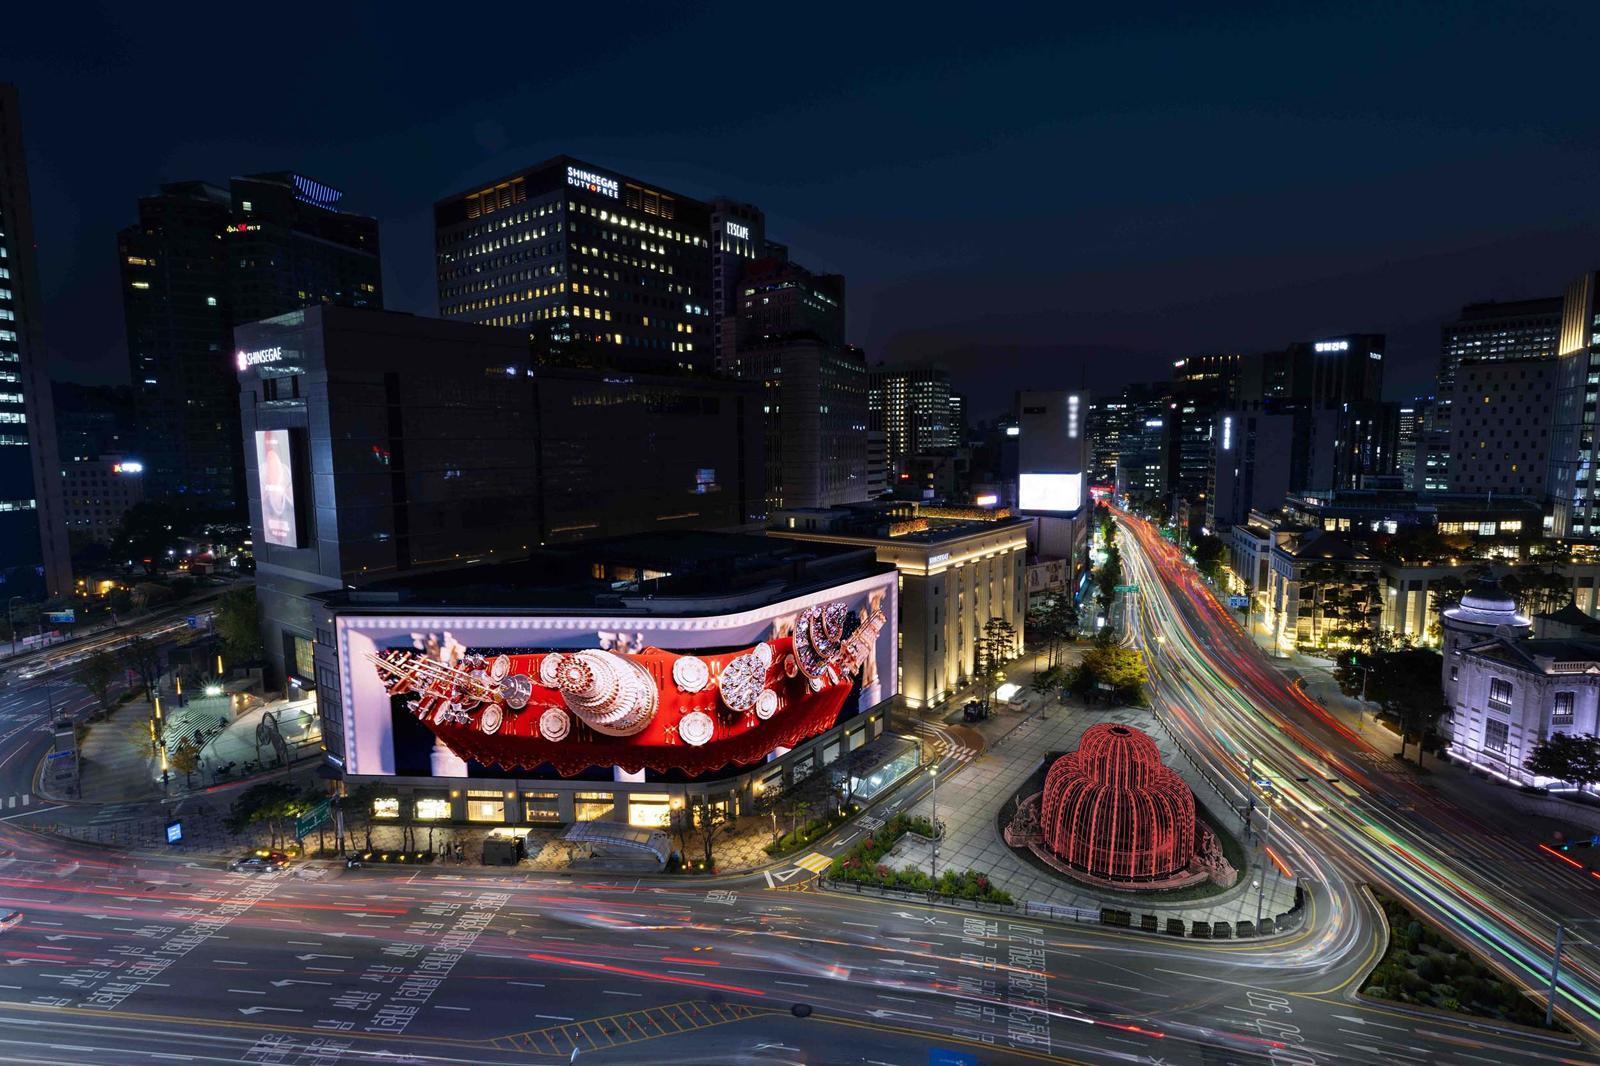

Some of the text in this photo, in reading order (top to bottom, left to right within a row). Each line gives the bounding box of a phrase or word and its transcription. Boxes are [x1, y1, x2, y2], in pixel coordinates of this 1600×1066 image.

[568, 167, 618, 190] SHINSEGAE
[568, 177, 618, 198] DUTY FREE
[247, 347, 282, 366] SHINSEGAE
